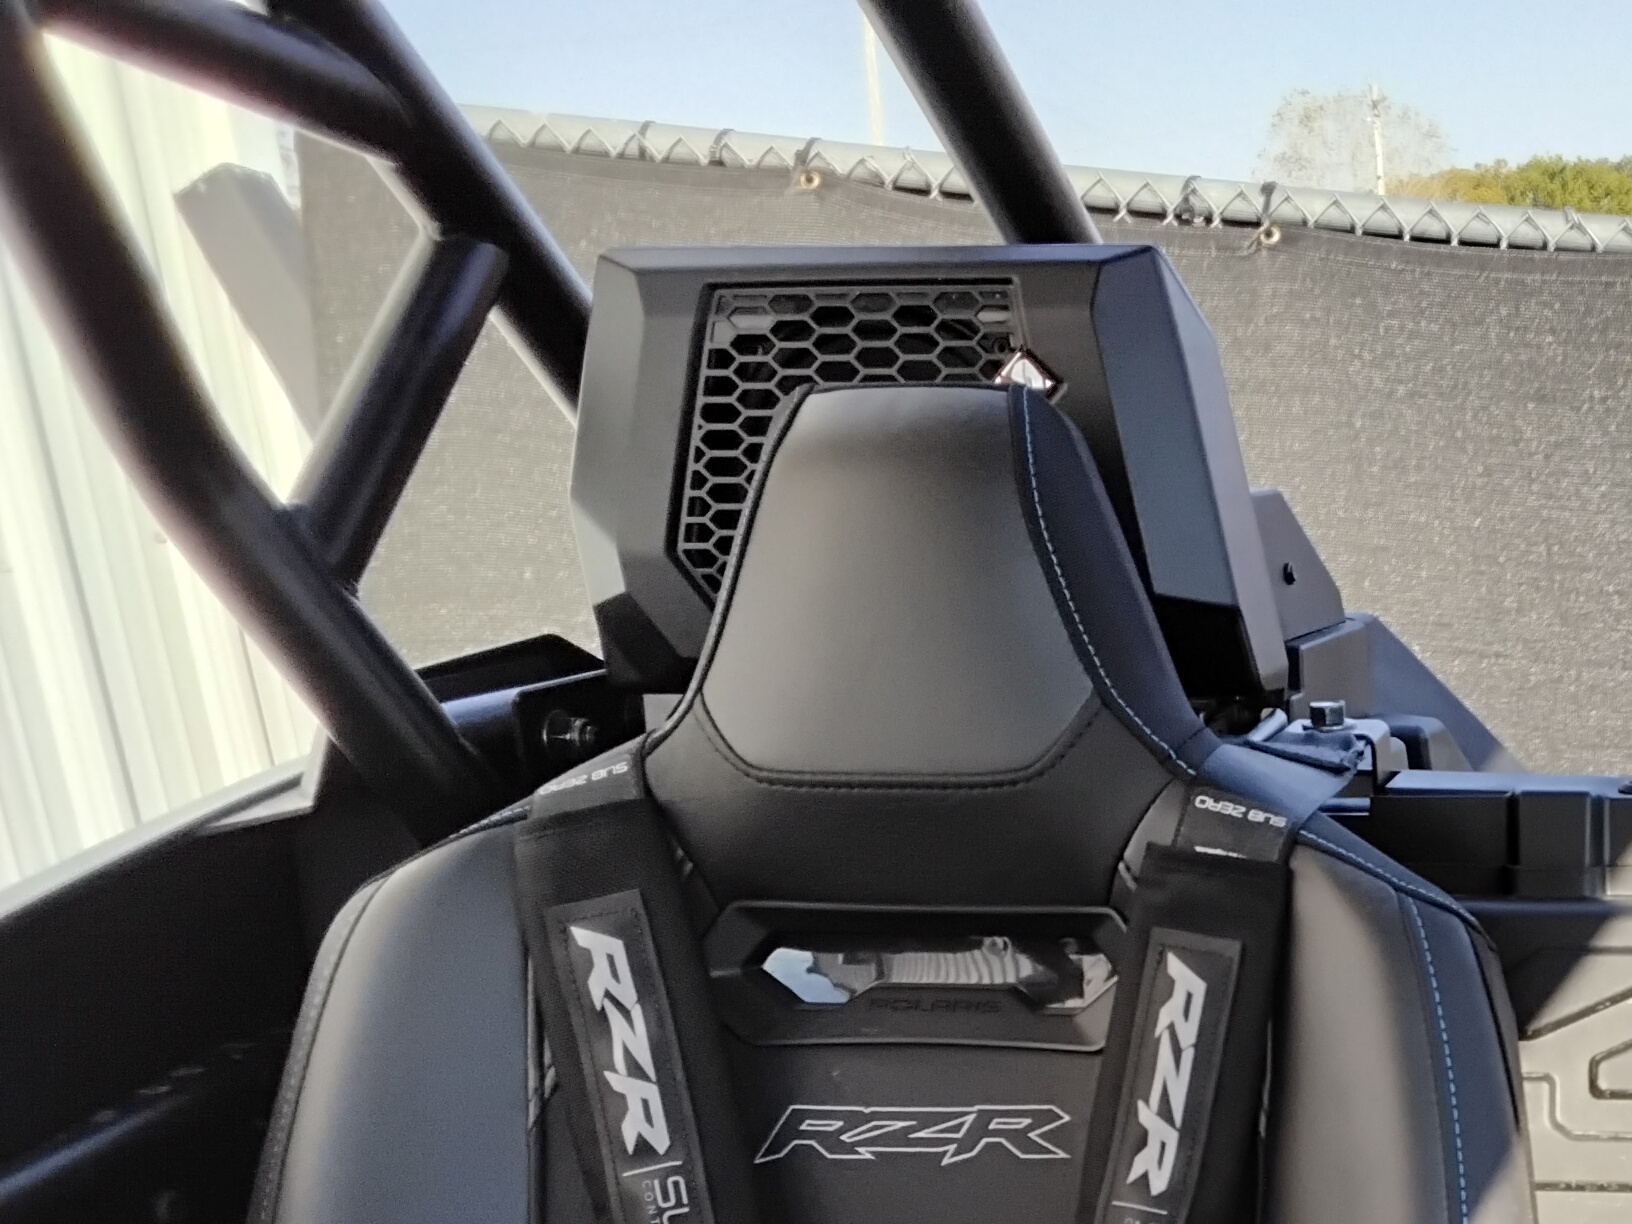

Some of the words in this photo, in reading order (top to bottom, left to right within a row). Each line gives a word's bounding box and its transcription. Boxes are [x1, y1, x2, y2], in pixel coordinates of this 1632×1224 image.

[1194, 795, 1246, 818] ZERO
[1247, 809, 1287, 828] SUB
[570, 926, 670, 1155] RZR
[1126, 951, 1207, 1196] RZR
[754, 1105, 1071, 1166] RZR
